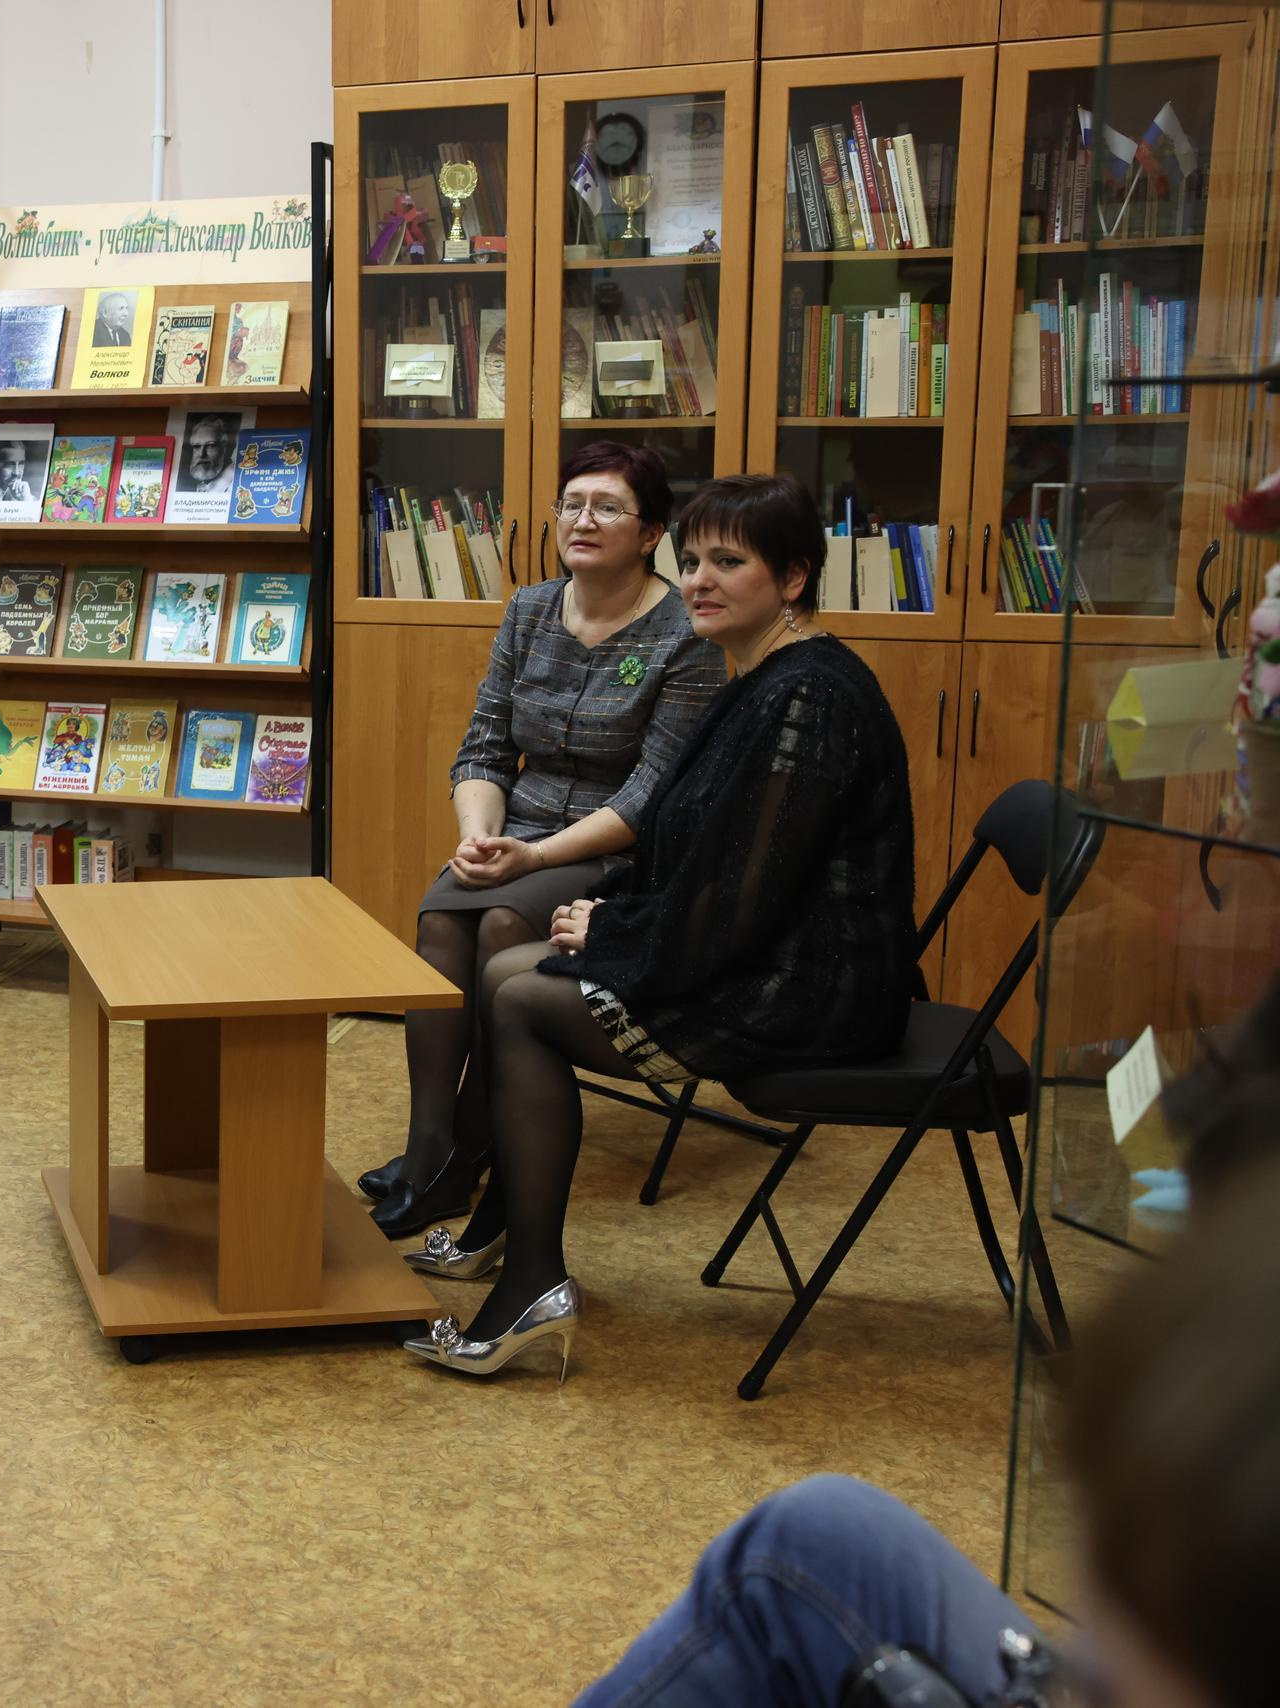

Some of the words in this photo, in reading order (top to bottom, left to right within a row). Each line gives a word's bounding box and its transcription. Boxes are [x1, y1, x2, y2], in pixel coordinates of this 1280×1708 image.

[158, 216, 246, 263] Александр
[249, 210, 312, 250] Волков
[172, 317, 211, 327] СКИТАНИЯ
[90, 369, 131, 379] Волков
